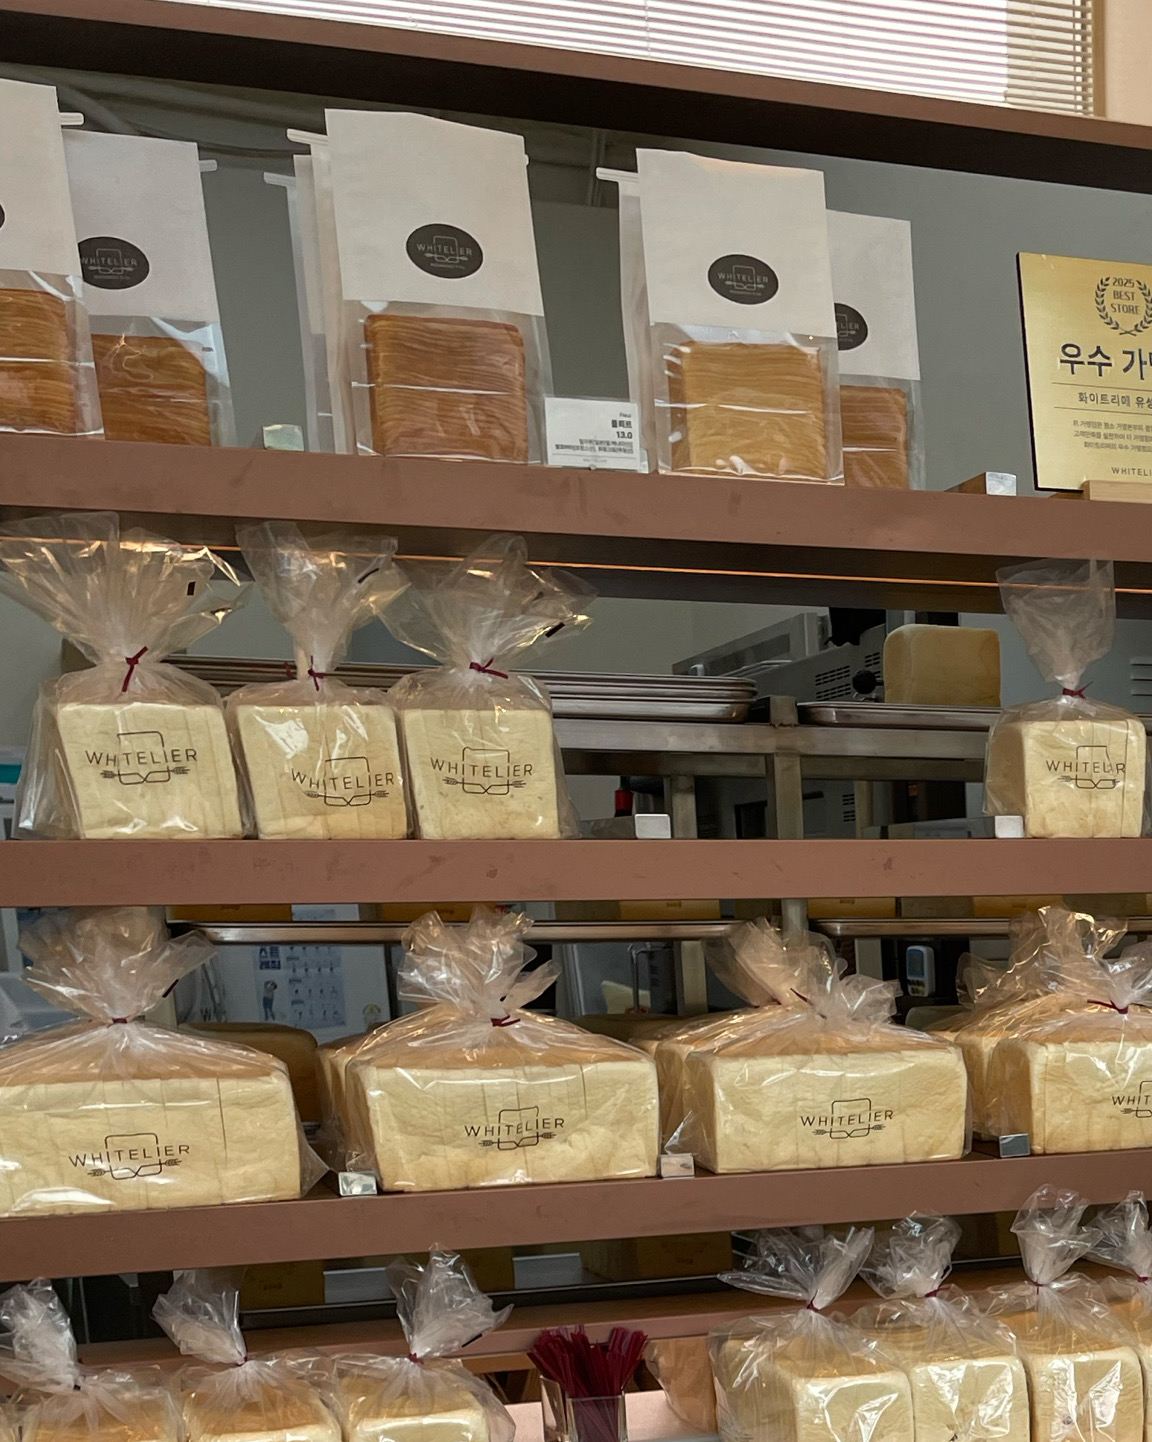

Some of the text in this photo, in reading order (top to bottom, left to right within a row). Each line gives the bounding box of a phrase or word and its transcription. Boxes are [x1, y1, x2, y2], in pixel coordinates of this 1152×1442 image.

[416, 243, 473, 256] WHITELIER
[80, 256, 138, 266] WHITELIER
[717, 272, 769, 283] WHITELIER
[1112, 277, 1135, 288] 2025
[1113, 290, 1135, 301] BEST
[1110, 303, 1140, 314] STORE
[1059, 343, 1112, 377] 우수
[1078, 392, 1131, 407] 화이트리에
[616, 431, 633, 439] 13.0
[85, 747, 198, 767] WHITELIER
[430, 758, 534, 778] WHITELIER
[1045, 760, 1126, 774] WHITELIR
[291, 768, 395, 791] WHITELIER
[800, 1109, 894, 1129] WHITELIER
[463, 1116, 565, 1139] WHITELIER
[67, 1143, 191, 1168] WHITELIER
